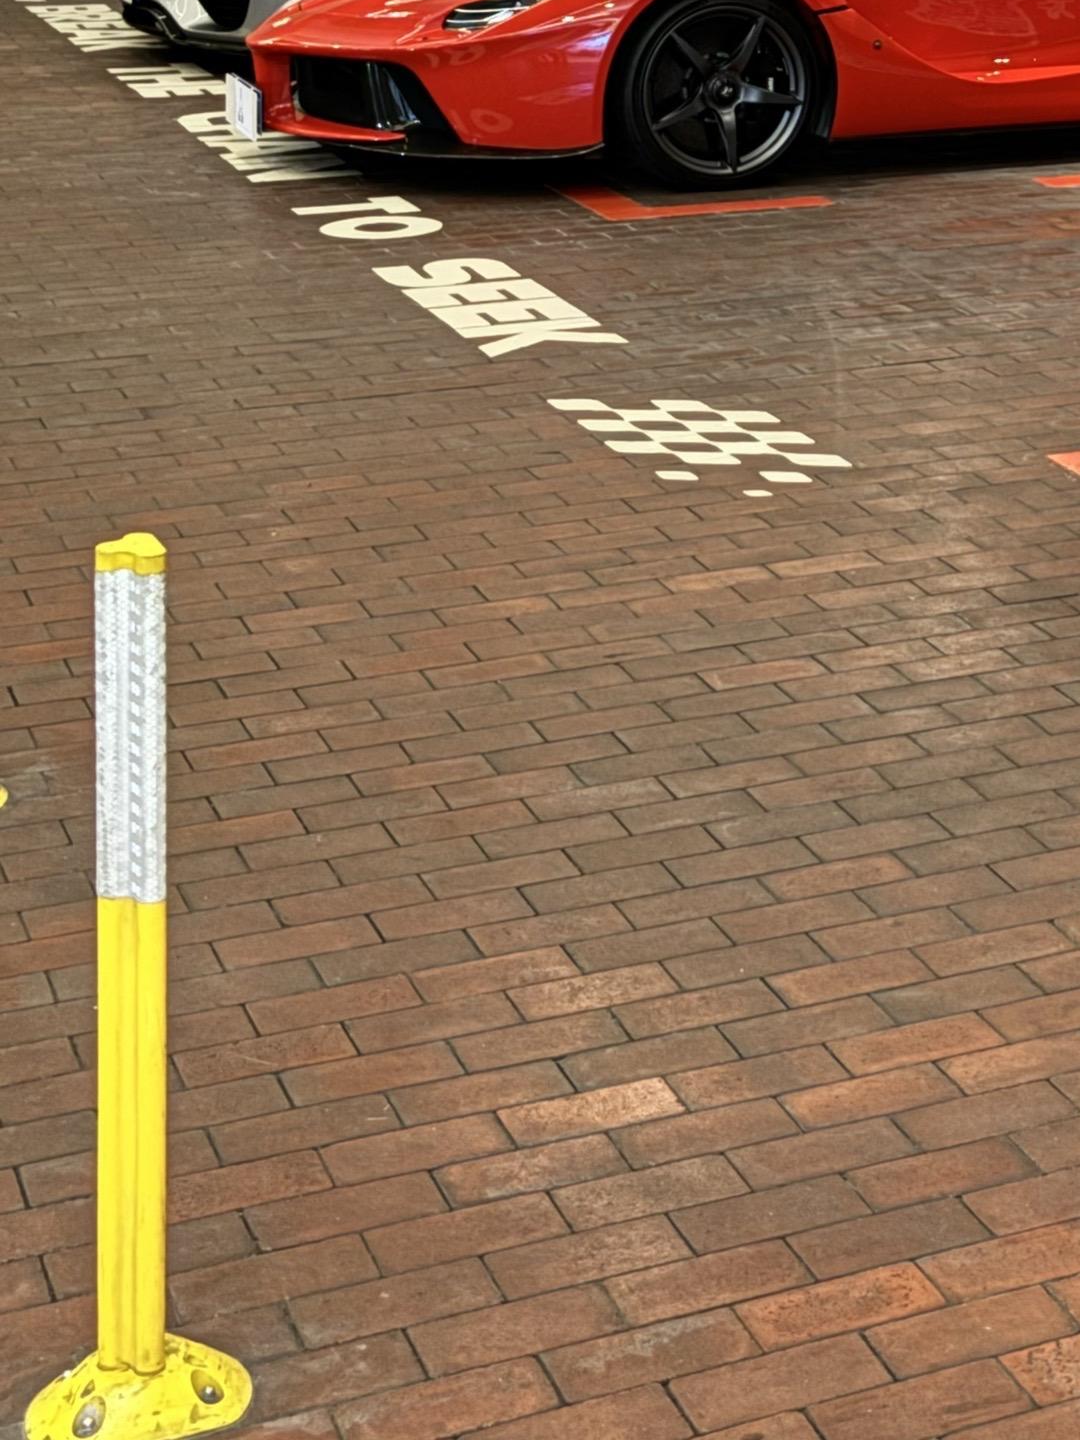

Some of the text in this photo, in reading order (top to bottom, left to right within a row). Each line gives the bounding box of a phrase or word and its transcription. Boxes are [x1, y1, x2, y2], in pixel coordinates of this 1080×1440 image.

[25, 3, 169, 53] BREAK
[106, 63, 228, 99] THE
[290, 195, 444, 240] TO
[371, 257, 630, 359] SEEK
